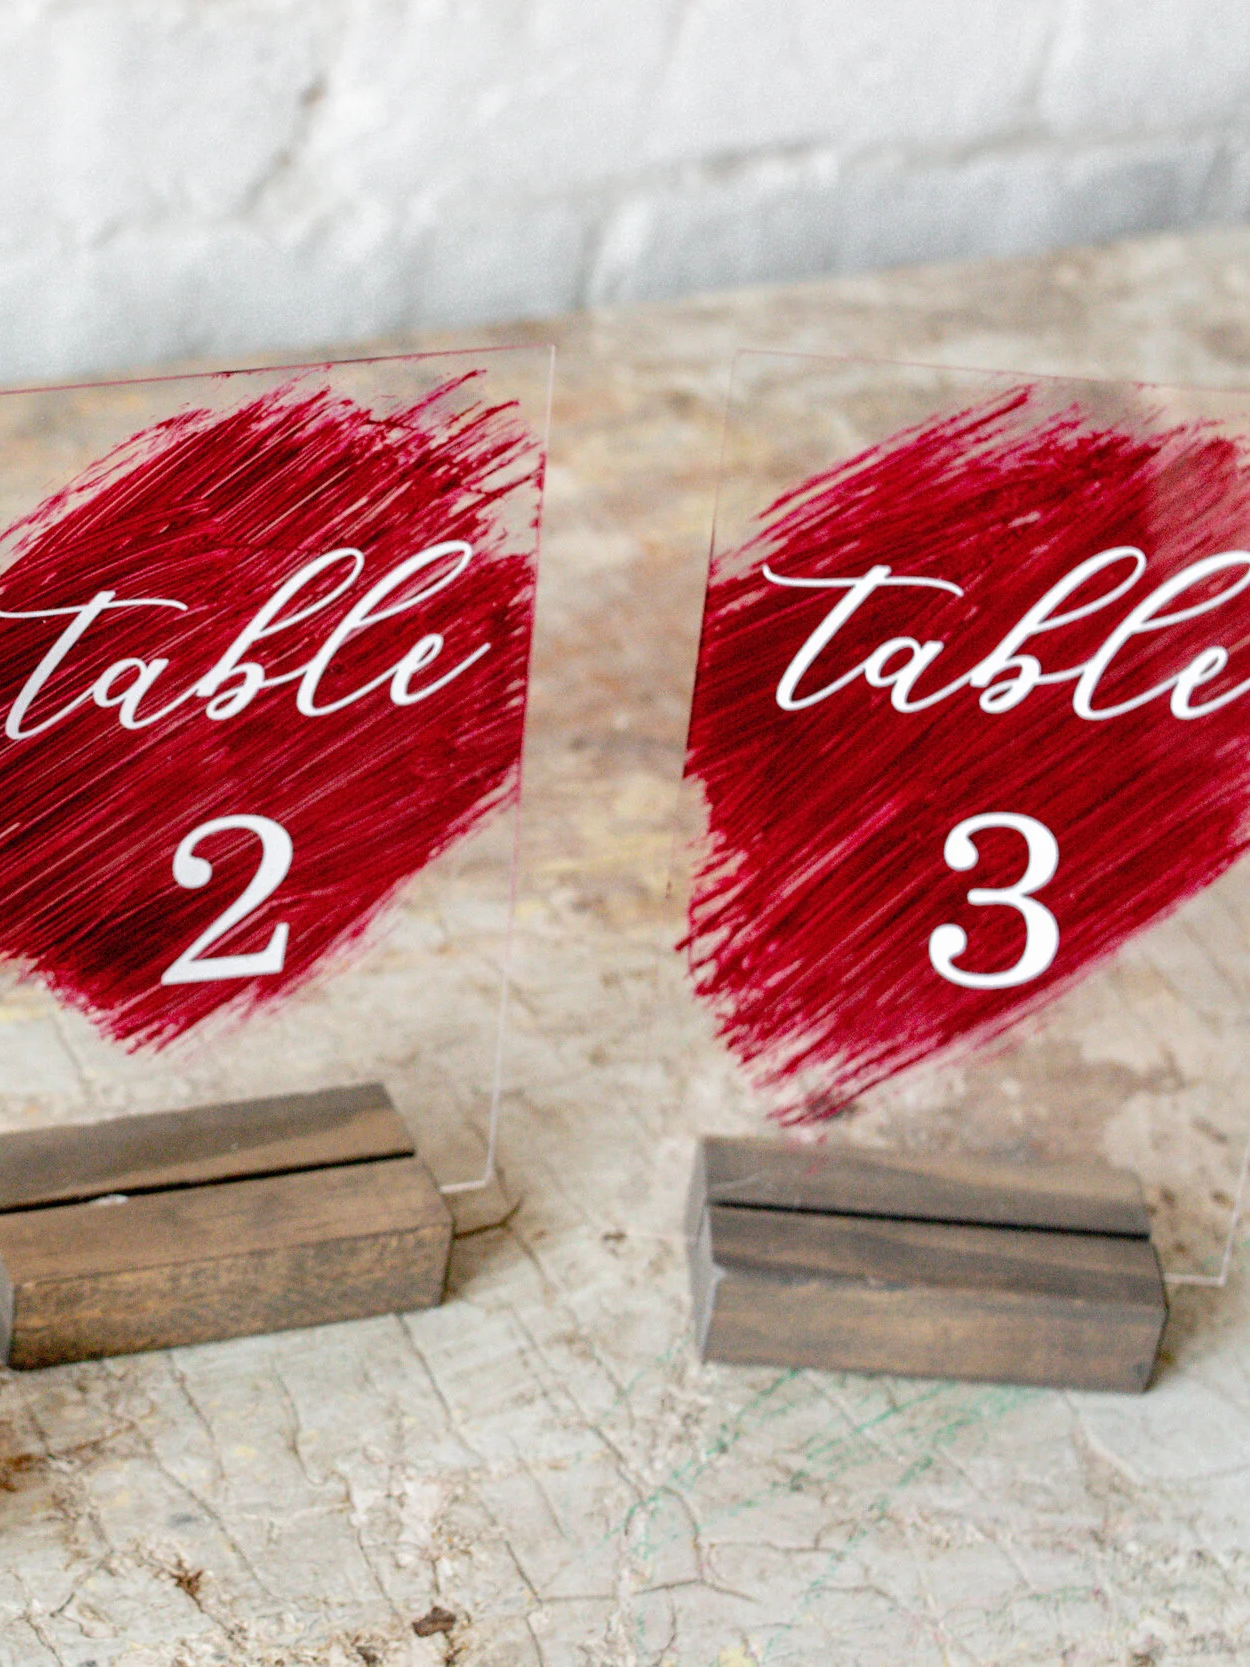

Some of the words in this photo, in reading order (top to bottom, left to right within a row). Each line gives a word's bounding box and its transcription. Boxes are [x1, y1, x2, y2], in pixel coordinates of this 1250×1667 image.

[762, 546, 1250, 720] table
[161, 814, 293, 985] 2
[928, 811, 1059, 989] 3
